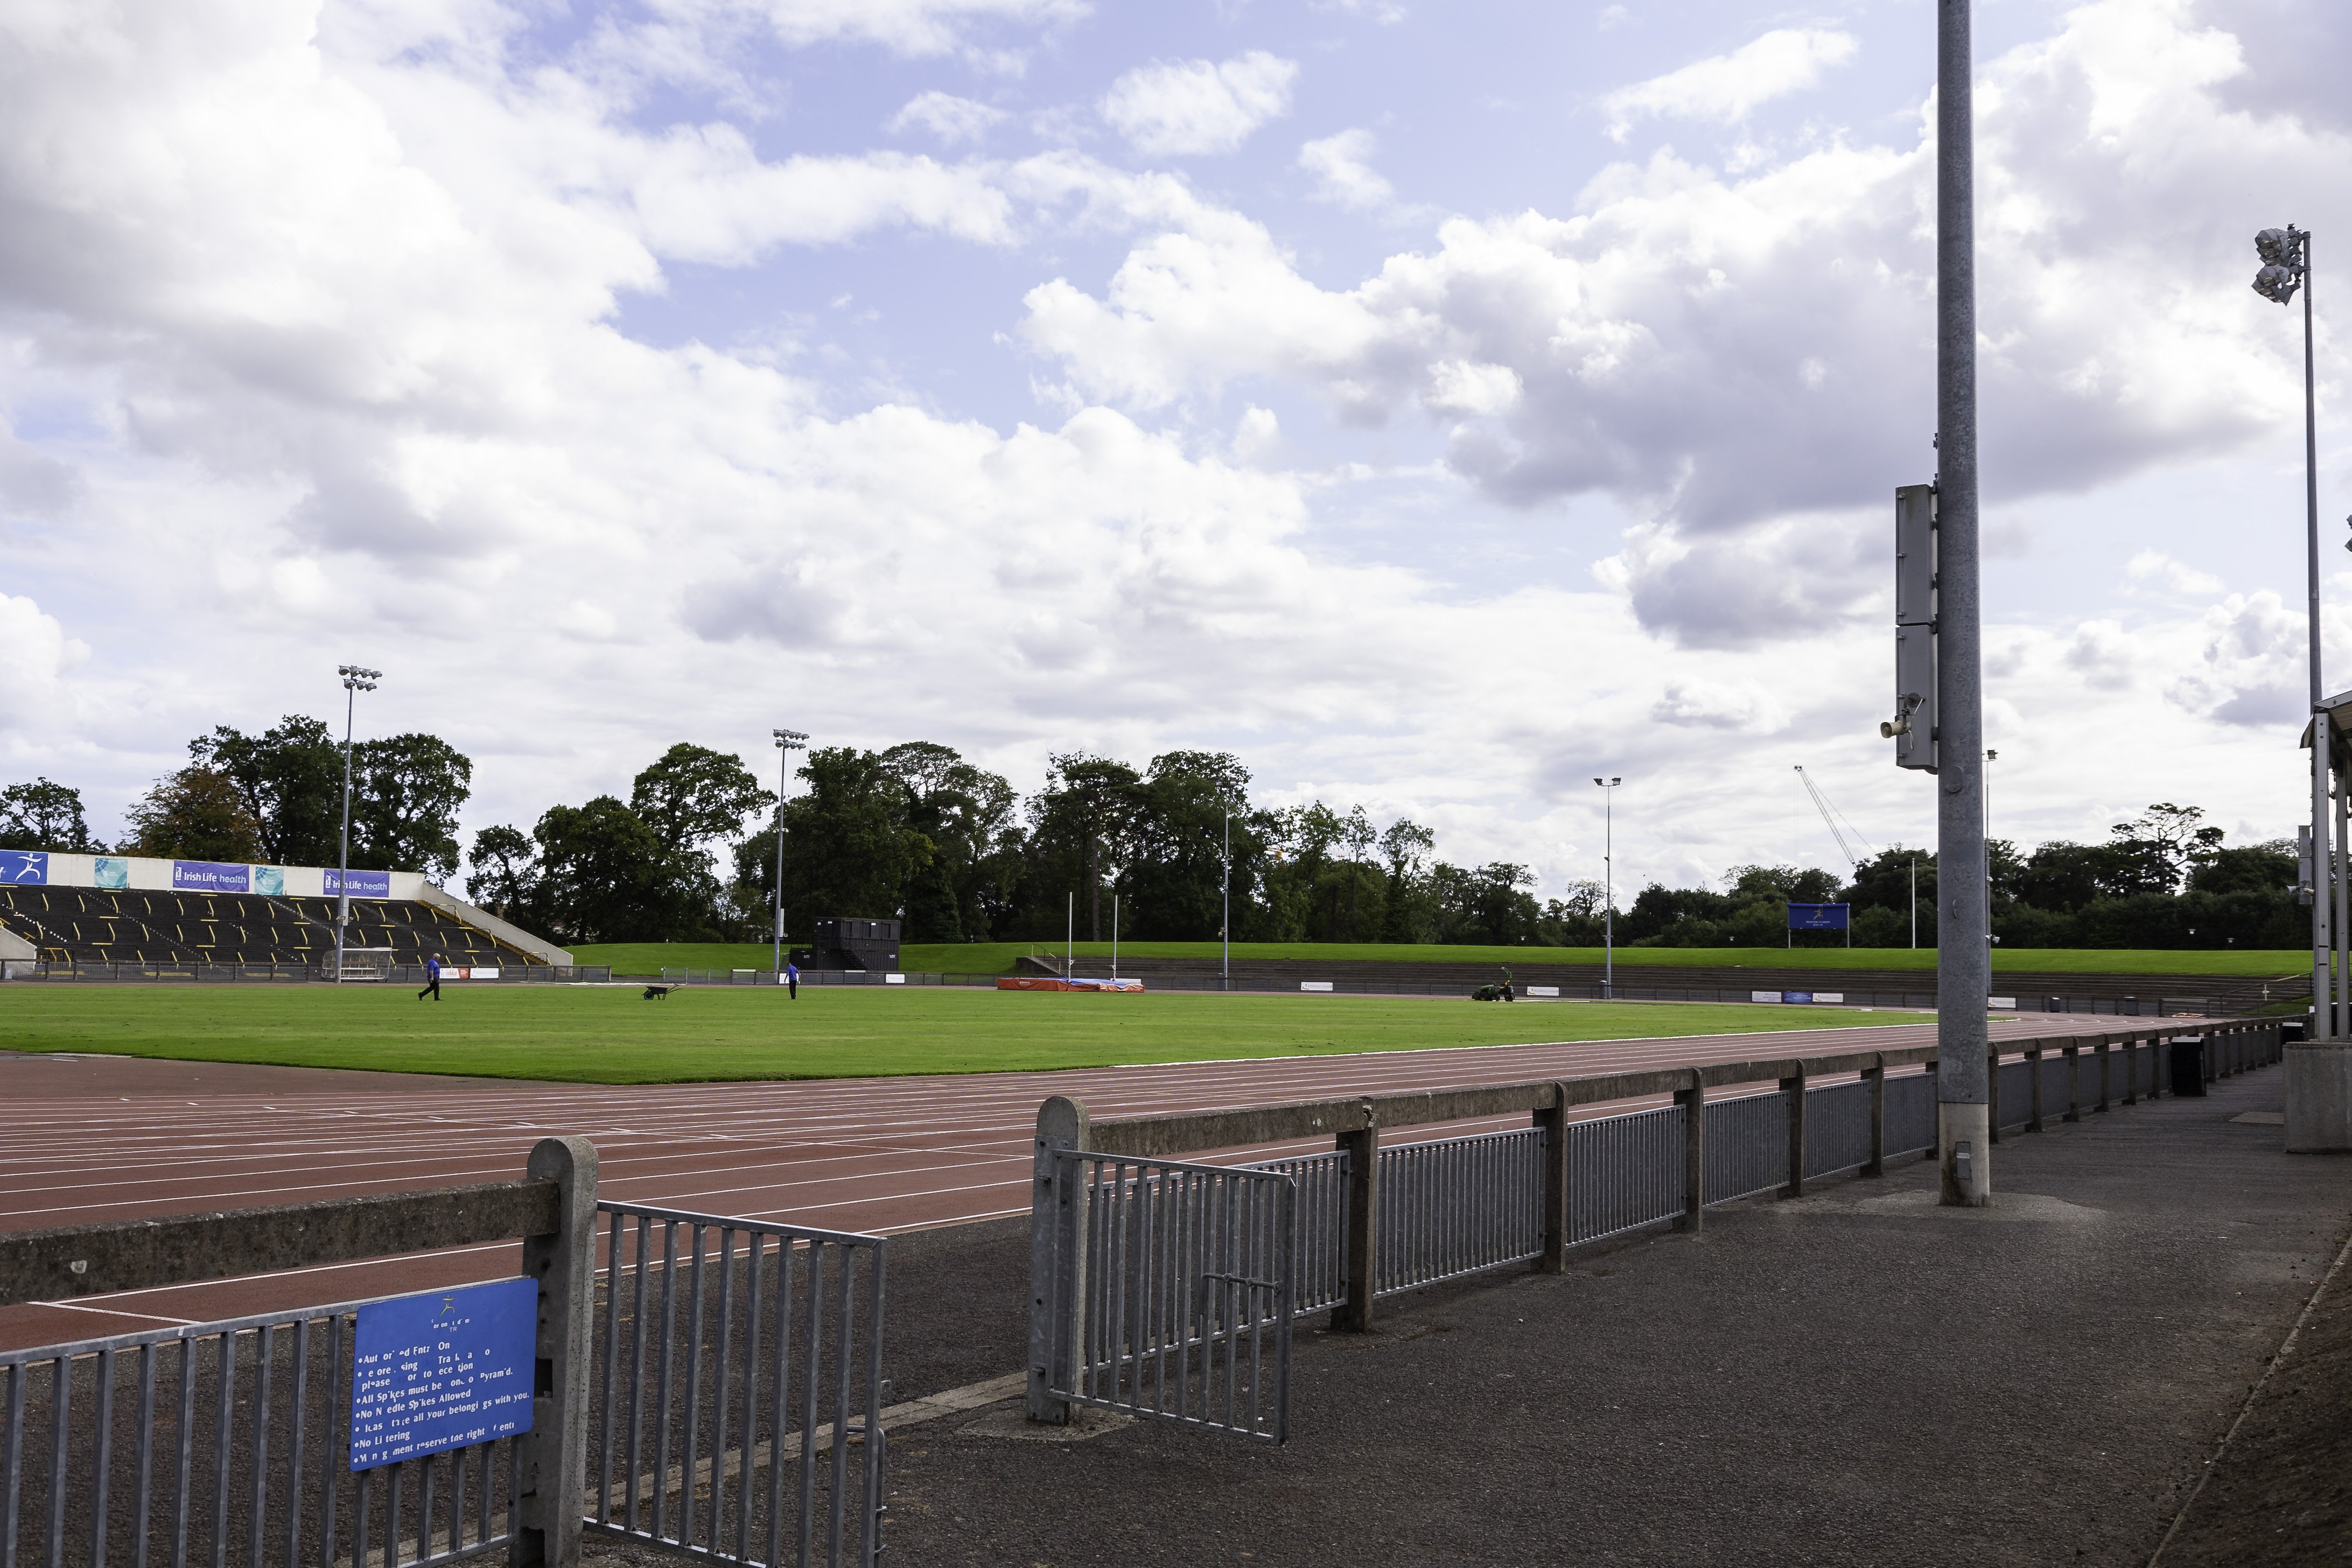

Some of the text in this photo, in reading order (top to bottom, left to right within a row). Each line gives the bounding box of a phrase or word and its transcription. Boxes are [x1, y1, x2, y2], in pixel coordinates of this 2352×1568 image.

[184, 872, 247, 884] Irish Life health
[333, 880, 387, 891] Irih Life health
[423, 1370, 432, 1378] to
[361, 1394, 374, 1405] All
[377, 1390, 405, 1403] Spkes
[408, 1384, 428, 1396] must
[431, 1382, 442, 1391] be
[480, 1367, 513, 1382] Pyramd.
[361, 1389, 471, 1419] No Nedle Spkes Allowed
[413, 1412, 424, 1423] all
[426, 1409, 446, 1420] your
[449, 1400, 492, 1415] belongigs
[495, 1394, 511, 1405] with
[513, 1392, 530, 1403] you.
[360, 1431, 410, 1448] No Litering
[467, 1427, 485, 1440] right
